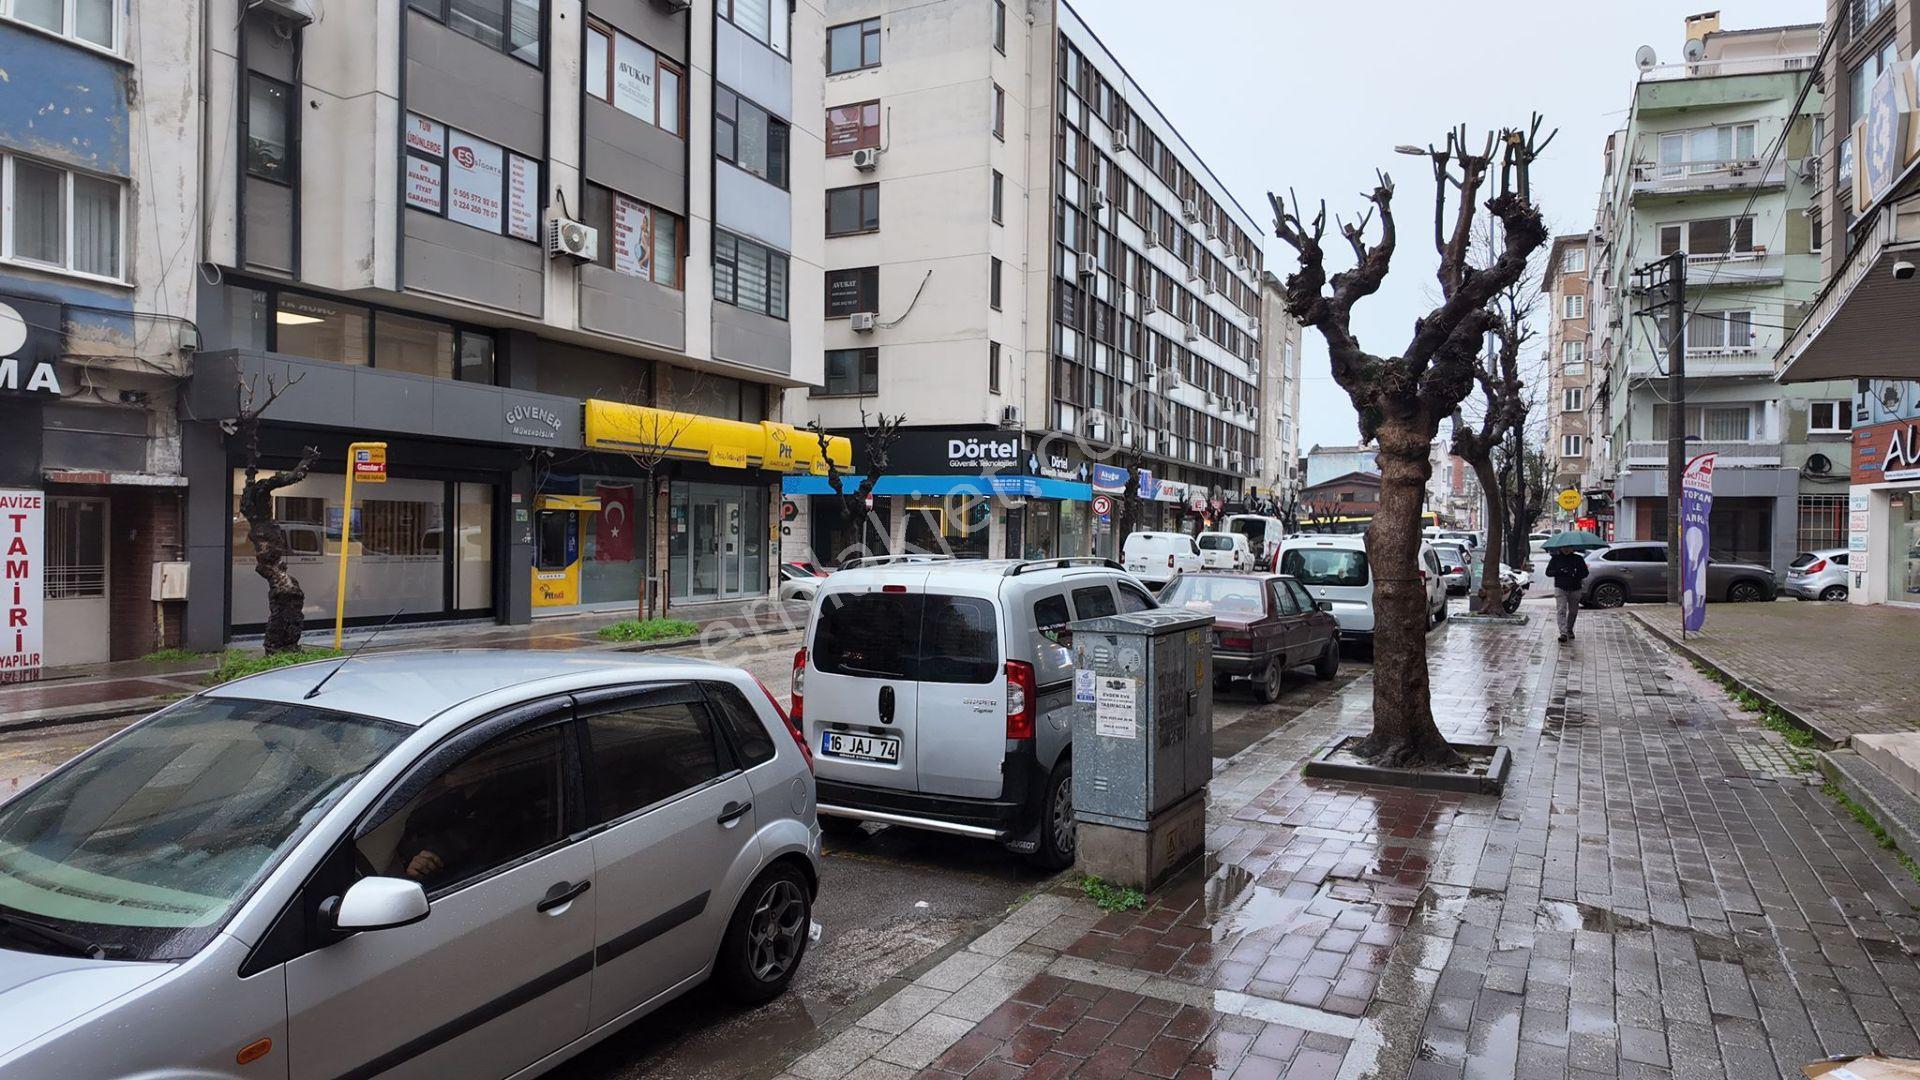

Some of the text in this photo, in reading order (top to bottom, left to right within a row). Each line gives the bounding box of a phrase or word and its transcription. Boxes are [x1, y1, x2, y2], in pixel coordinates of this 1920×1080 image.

[619, 61, 651, 86] AVUKAT
[505, 404, 562, 431] GÜVENER
[778, 443, 793, 459] Ptt
[948, 438, 1018, 458] Dörtel
[949, 459, 978, 467] Güvenlik
[1051, 456, 1068, 469] Dörtel
[0, 493, 41, 509] AVİZE
[6, 514, 28, 652] TAMİRİ
[0, 655, 40, 669] YAPILIR
[831, 735, 895, 757] 16 JAJ 74
